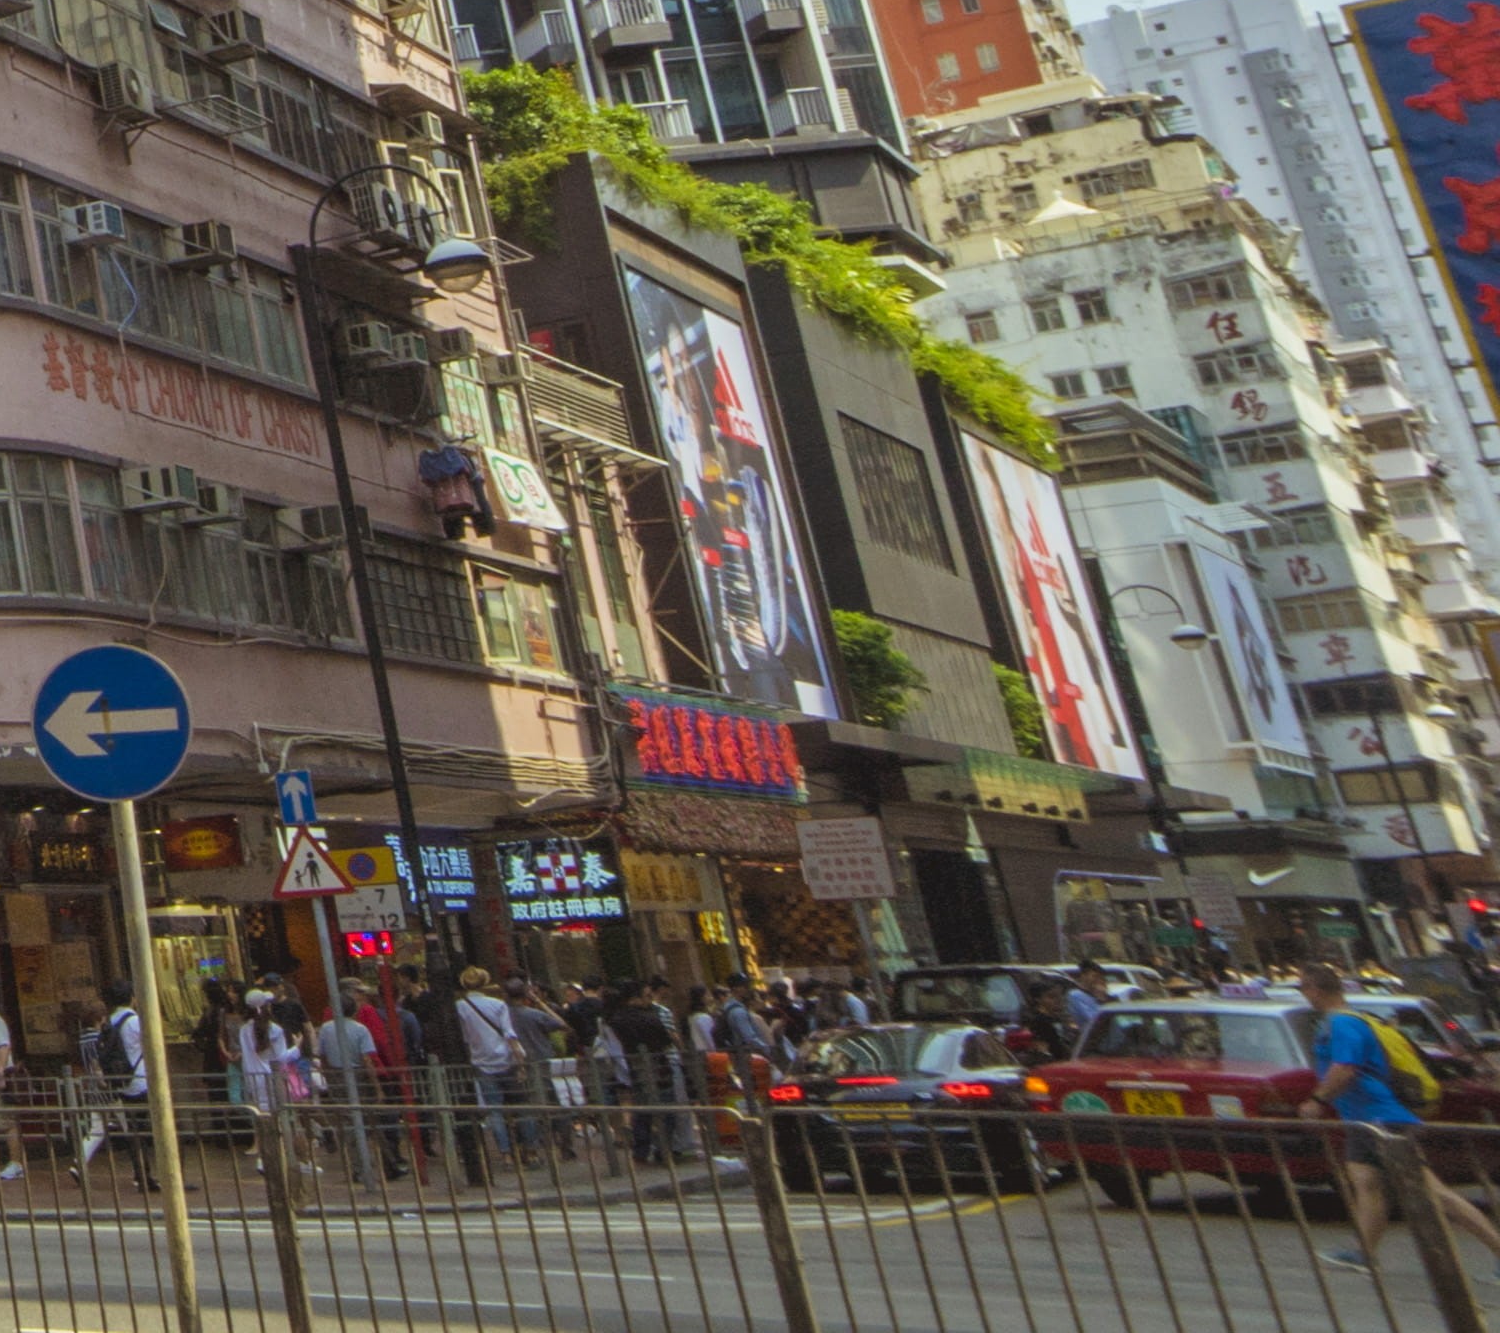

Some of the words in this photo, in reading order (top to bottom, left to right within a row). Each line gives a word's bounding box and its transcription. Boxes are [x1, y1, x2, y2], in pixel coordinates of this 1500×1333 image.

[510, 897, 624, 922] 政府註冊藥房
[379, 913, 400, 930] 12
